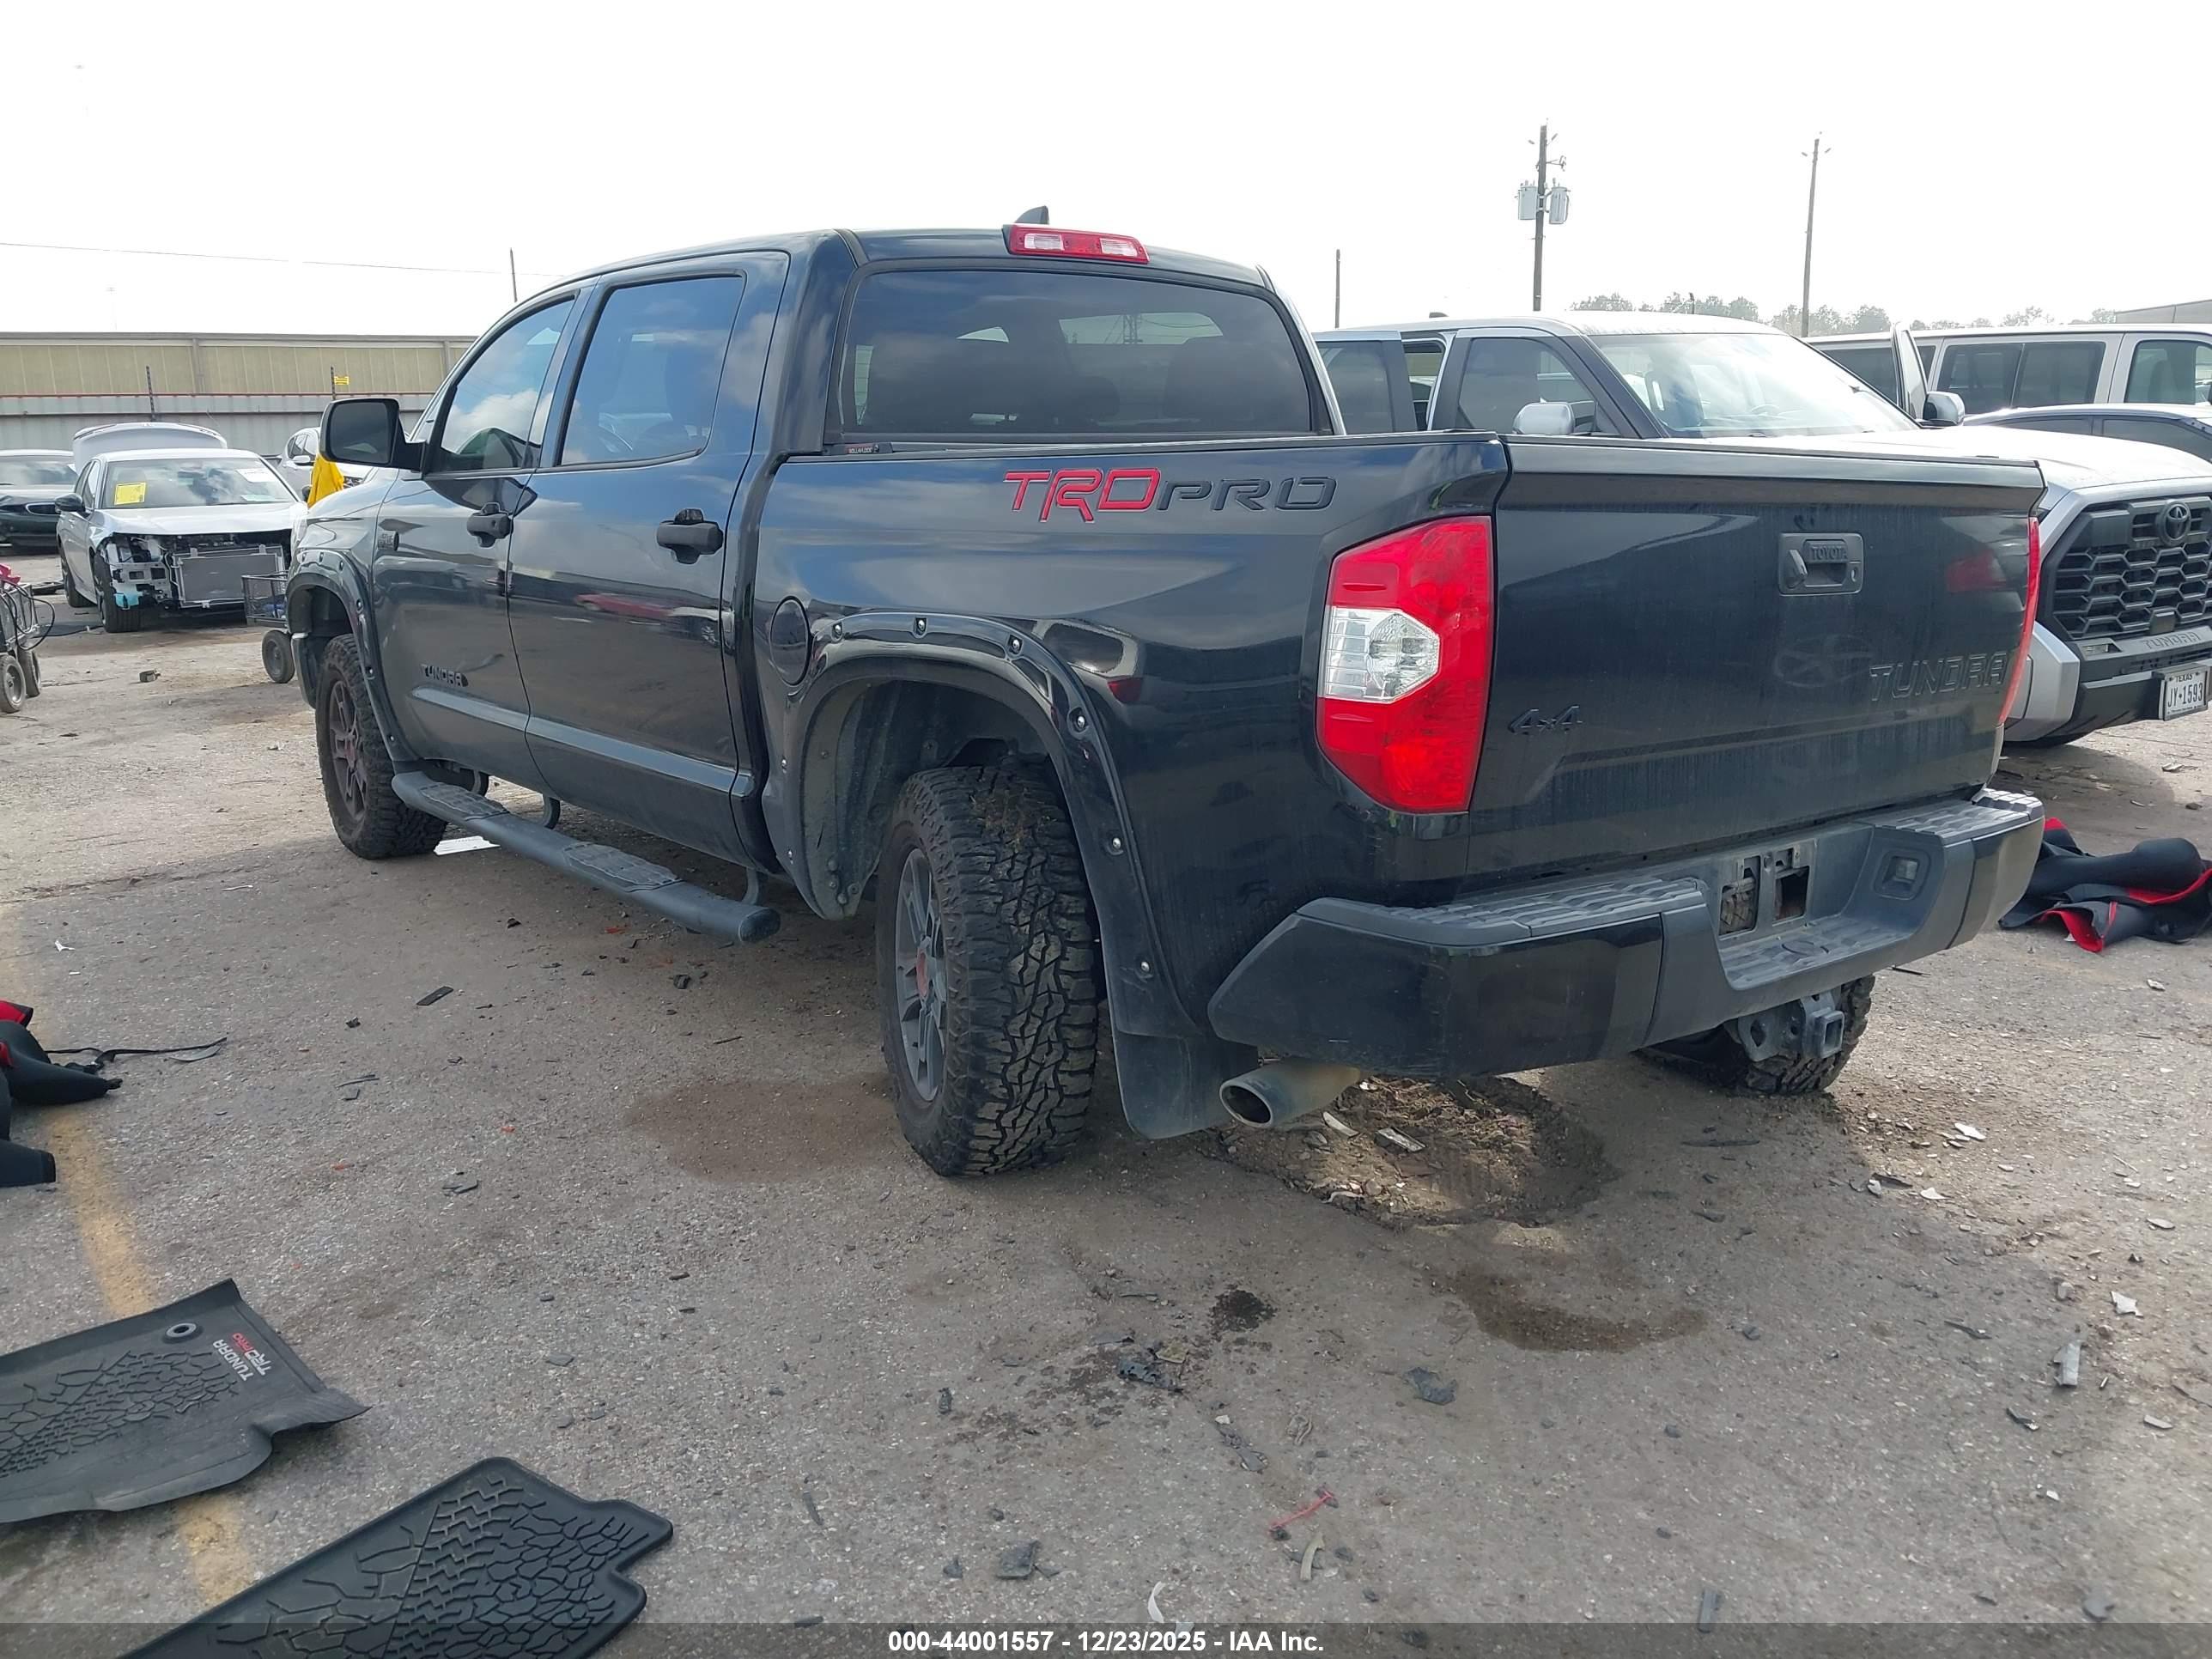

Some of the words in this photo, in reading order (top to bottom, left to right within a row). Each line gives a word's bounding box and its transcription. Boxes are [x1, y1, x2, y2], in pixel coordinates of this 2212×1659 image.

[1004, 467, 1160, 523] TRD
[1157, 476, 1337, 511] PRO
[1812, 545, 1848, 561] TOYOTA
[2143, 632, 2201, 649] TUNDRA
[421, 664, 469, 687] TUNDRA
[1869, 652, 2008, 701] TUNDRA
[2175, 673, 2193, 684] TEXAS
[213, 1340, 253, 1381] TUNDRA
[245, 1350, 271, 1375] TRD
